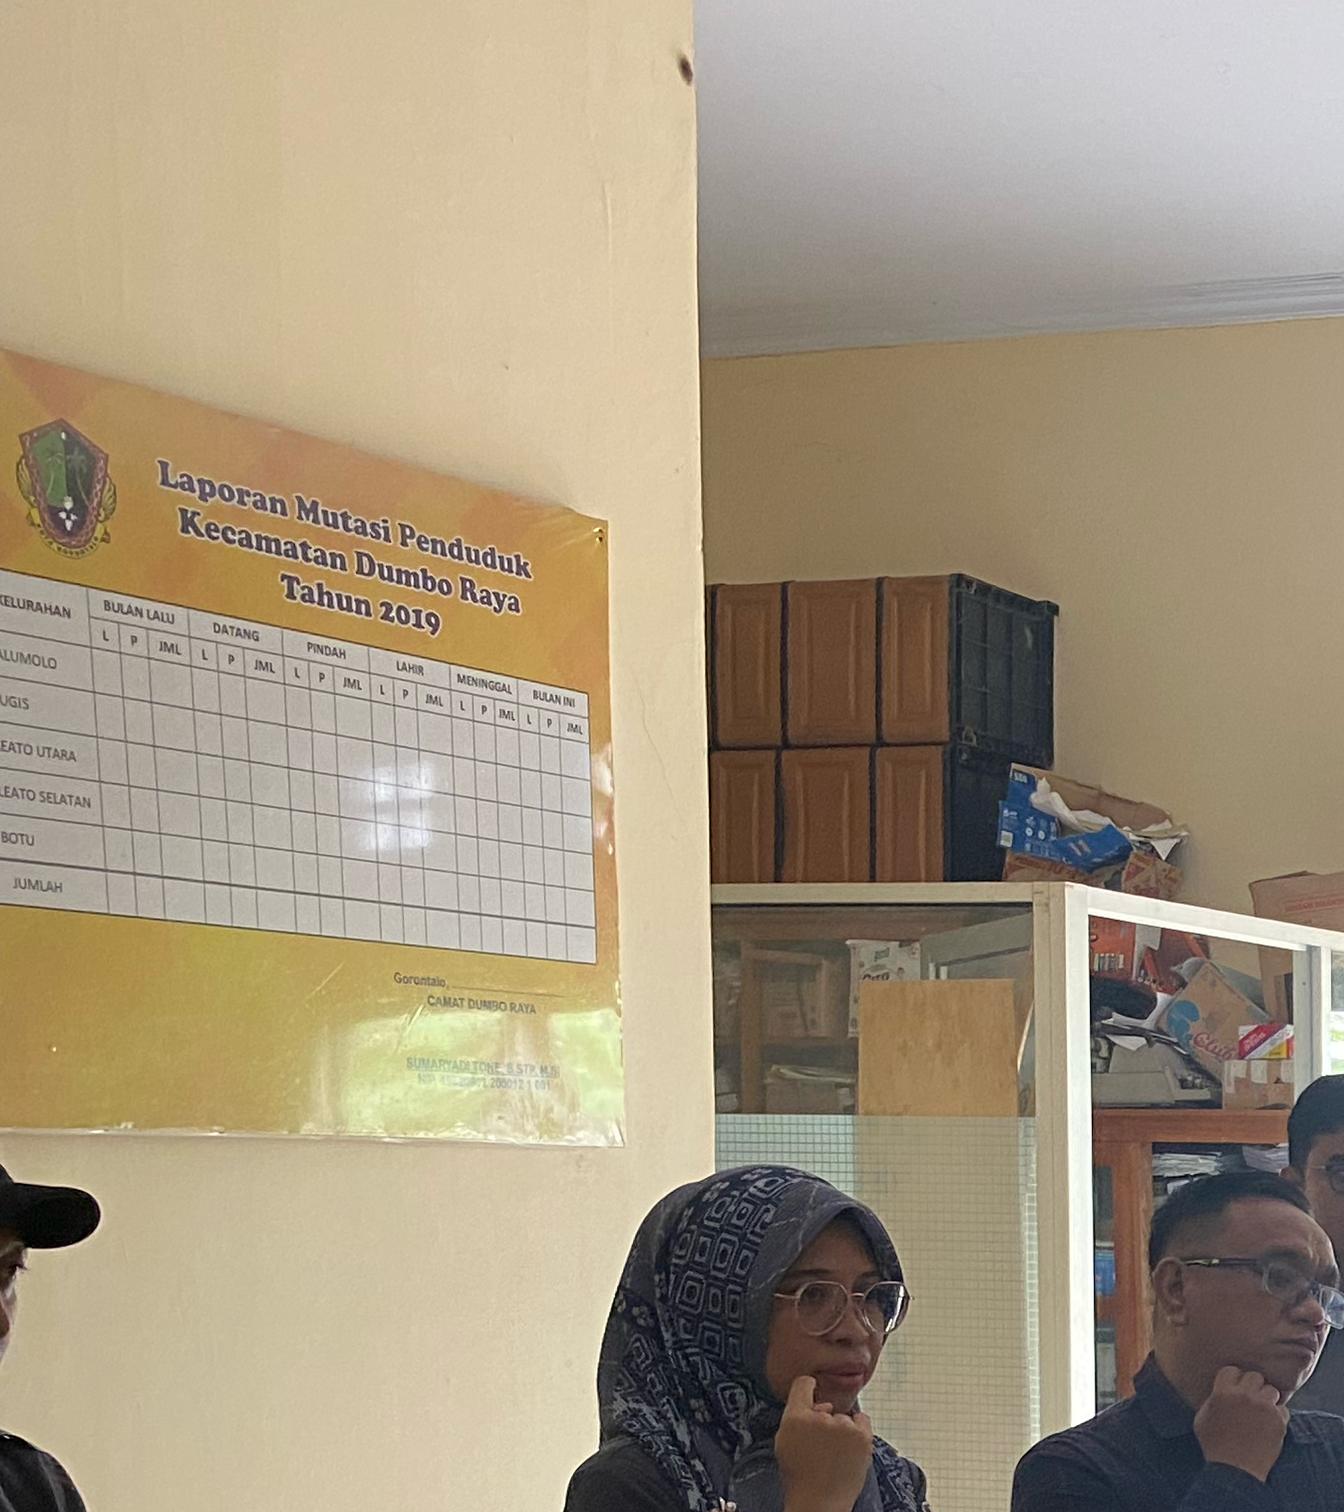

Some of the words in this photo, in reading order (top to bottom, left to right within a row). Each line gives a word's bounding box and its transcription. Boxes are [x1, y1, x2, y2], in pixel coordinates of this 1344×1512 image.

[157, 459, 288, 517] Laporan
[295, 495, 391, 543] Mutasi
[398, 522, 532, 579] Penduduk
[178, 507, 347, 572] Kecamatan
[355, 551, 453, 596] Dumbo
[459, 576, 520, 614] Raya
[280, 573, 372, 617] Tahun
[380, 601, 440, 635] 2019
[104, 600, 143, 618] BULAN
[146, 608, 175, 624] LALU
[103, 629, 109, 641] L
[213, 622, 260, 642] DATANG
[130, 635, 138, 646] P
[159, 641, 182, 655] JML
[307, 641, 346, 660] PINDAH
[202, 650, 208, 660] L
[228, 654, 235, 665] P
[254, 659, 276, 673] JML
[294, 667, 300, 678] L
[396, 660, 424, 676] LAHIR
[319, 672, 325, 682] P
[343, 677, 362, 690] JML
[379, 685, 385, 695] L
[457, 673, 512, 695] MENINGGAL
[403, 689, 409, 699] P
[425, 694, 443, 707] JML
[533, 690, 561, 705] BULAN
[563, 698, 575, 708] INI
[460, 701, 465, 711] L
[482, 705, 488, 715] P
[499, 709, 515, 721] JML
[527, 715, 532, 724] L
[547, 719, 552, 728] P
[567, 723, 583, 735] JML
[37, 746, 77, 762] UTARA
[40, 790, 91, 808] SELATAN
[1, 831, 35, 846] BOTU
[13, 877, 63, 893] JUMLAH
[427, 995, 465, 1009] CAMAT
[468, 998, 507, 1012] DUMBO
[510, 1002, 537, 1014] RAYA
